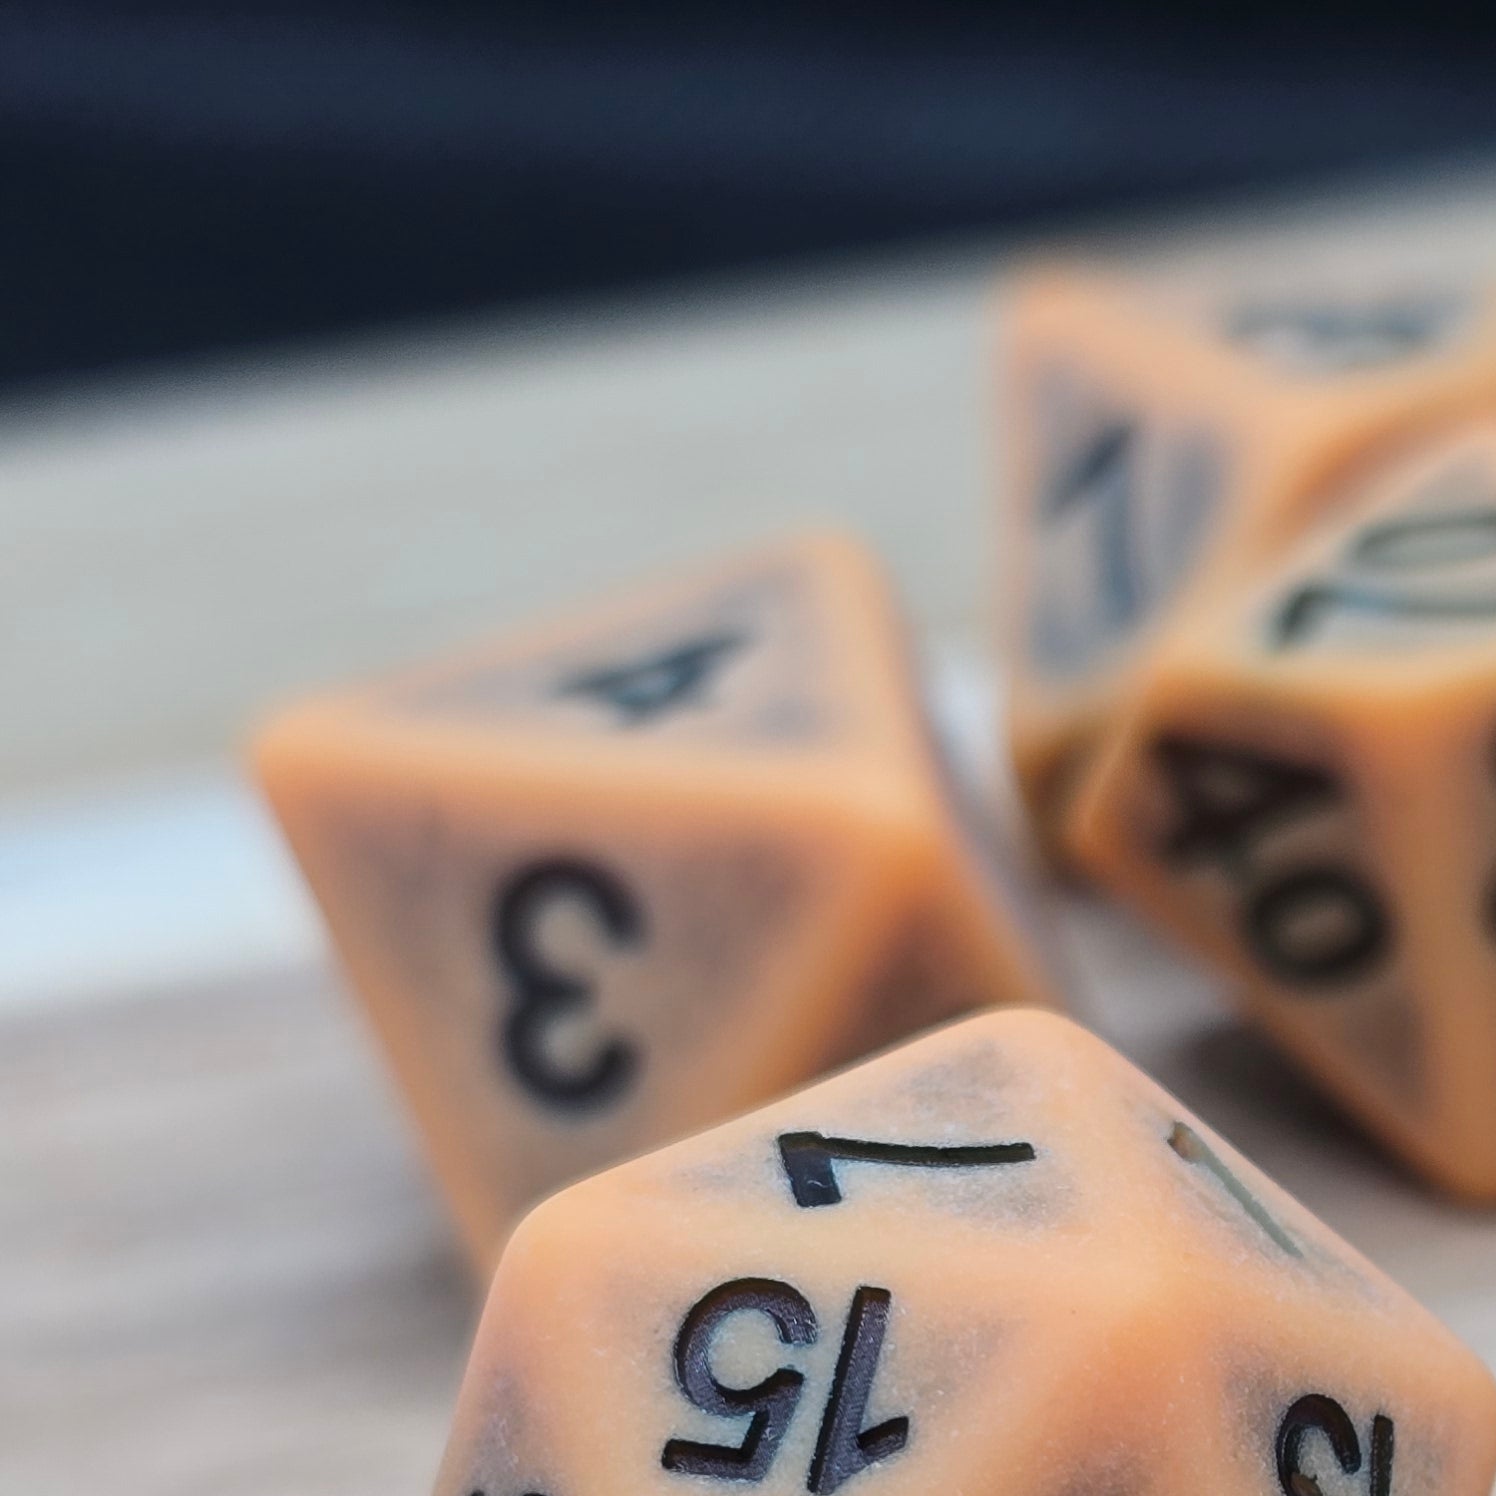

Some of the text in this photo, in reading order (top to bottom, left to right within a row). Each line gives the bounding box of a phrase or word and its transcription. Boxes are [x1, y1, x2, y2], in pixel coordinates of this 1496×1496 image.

[490, 850, 650, 1112] 3
[776, 1131, 1036, 1208] 7
[661, 1276, 910, 1496] 15
